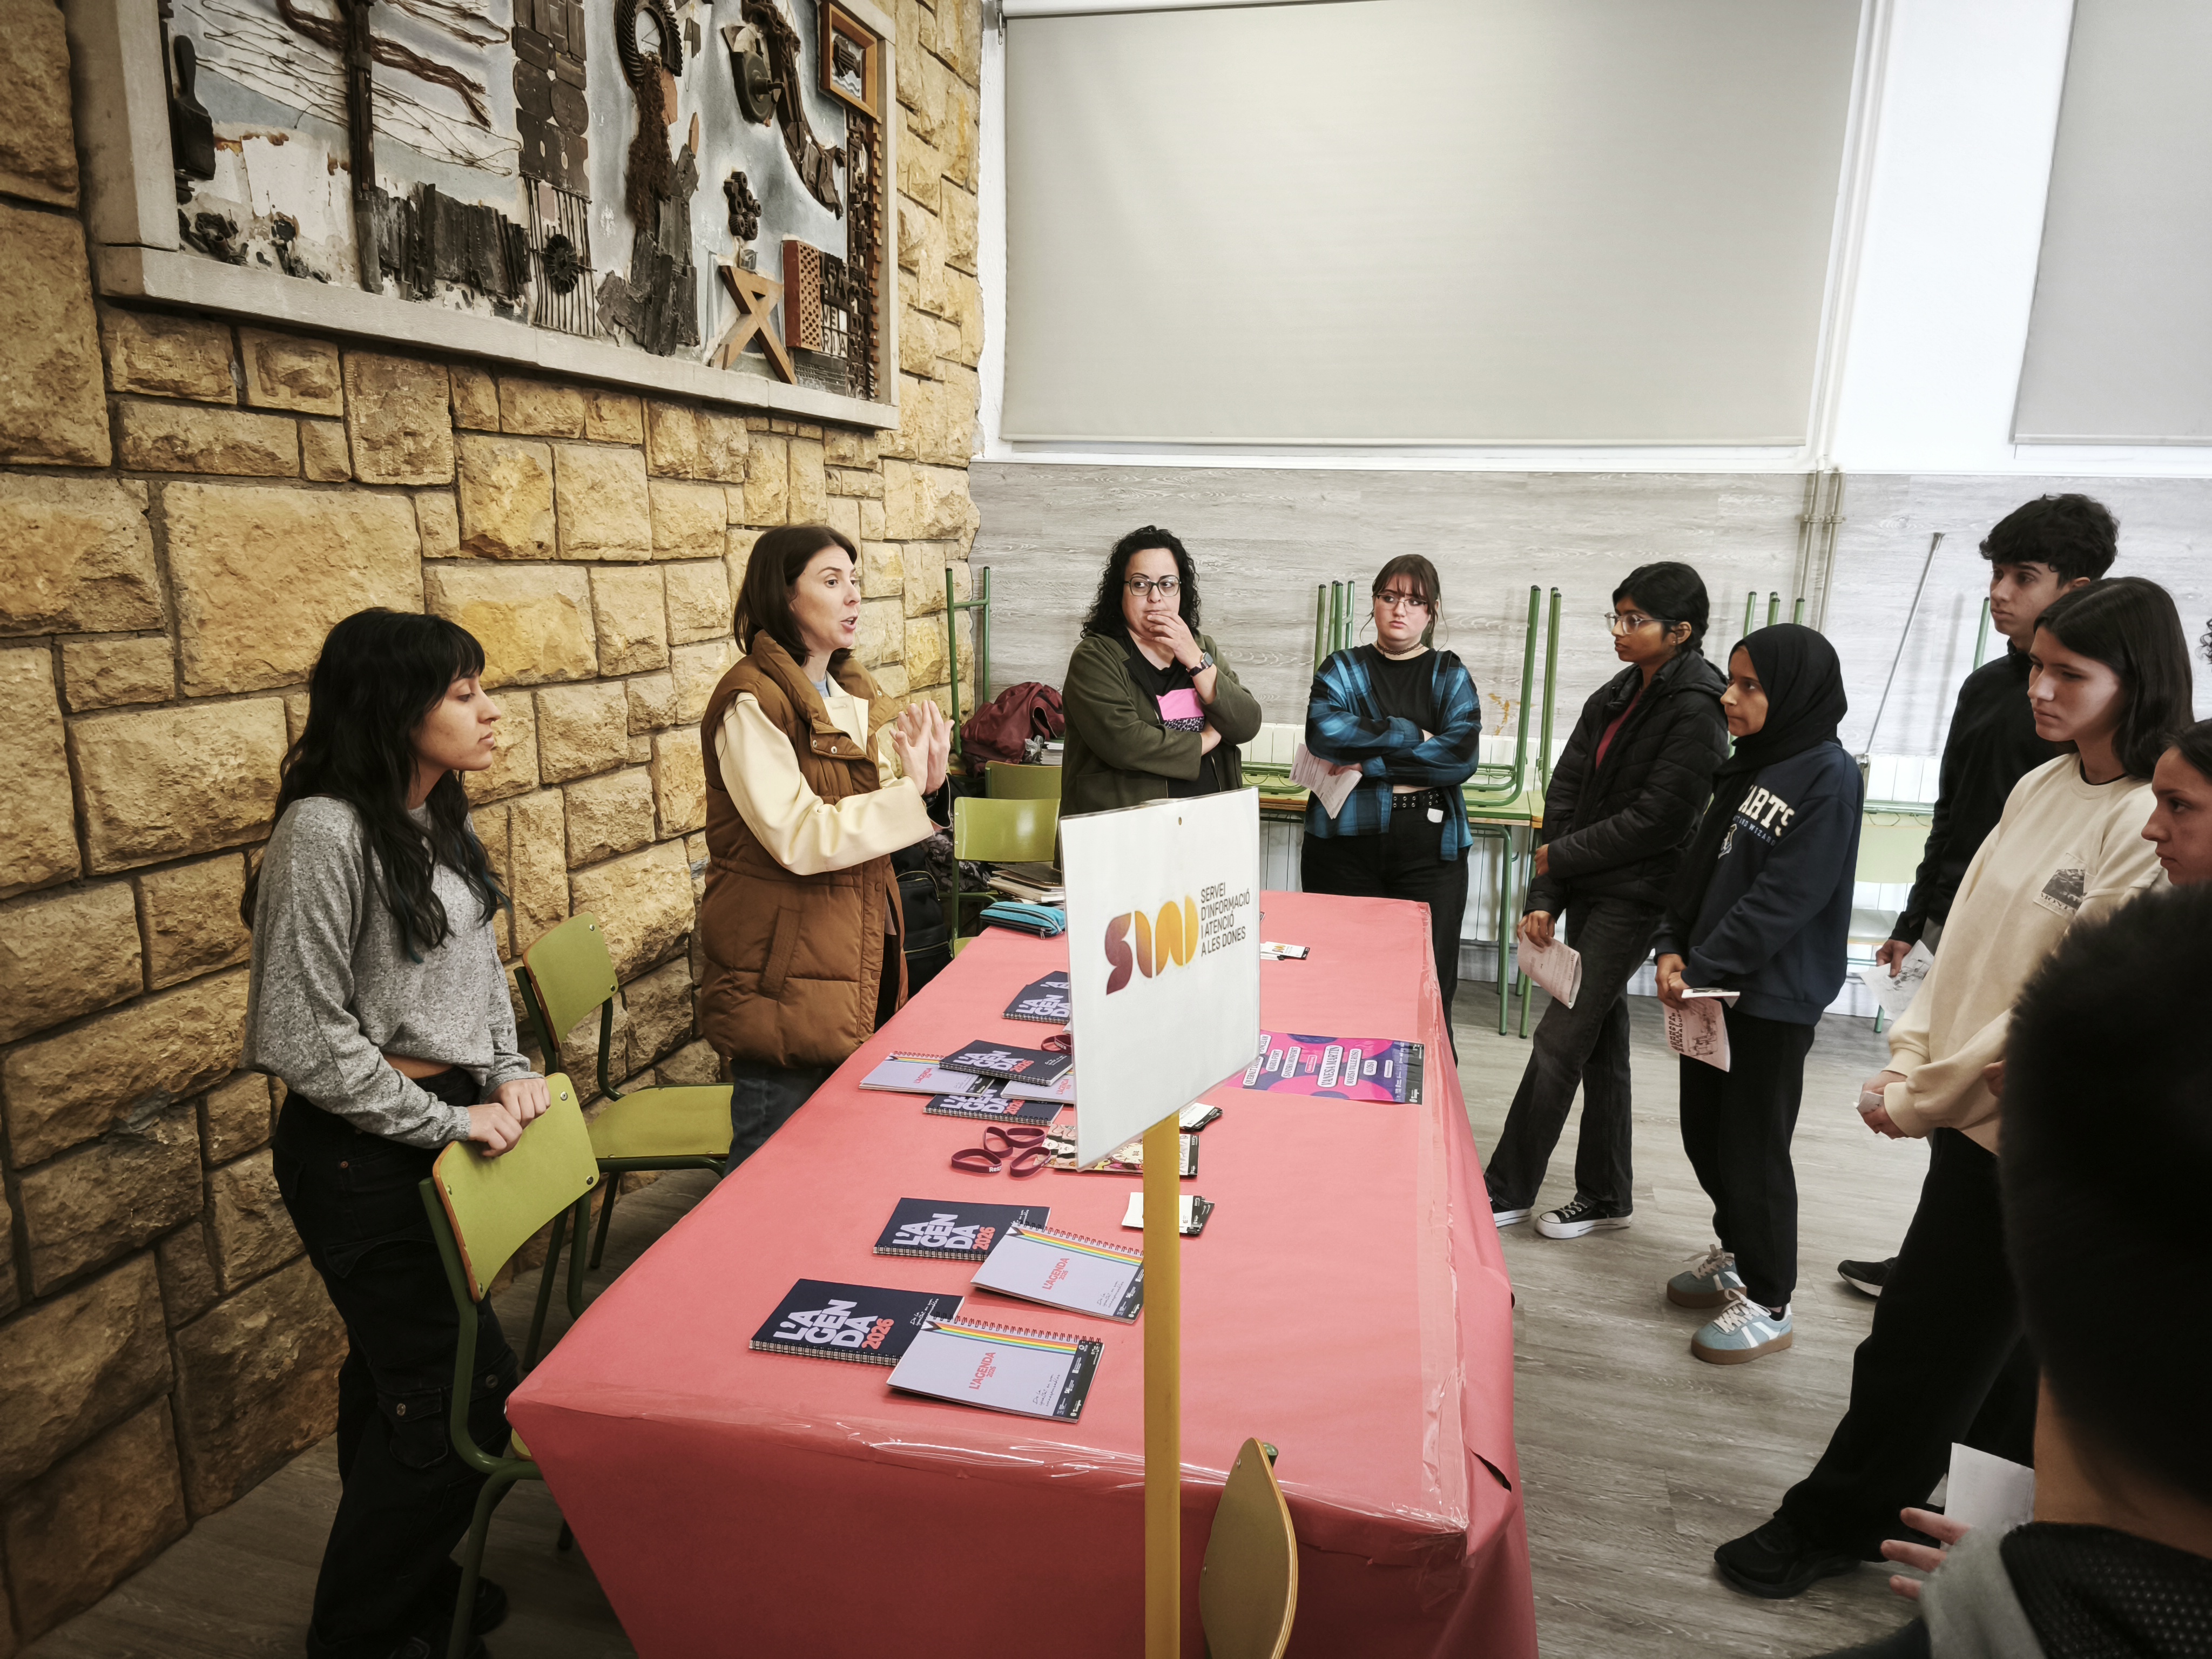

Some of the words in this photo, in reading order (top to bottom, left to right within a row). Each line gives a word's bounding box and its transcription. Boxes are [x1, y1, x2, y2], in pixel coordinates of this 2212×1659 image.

[1201, 882, 1226, 903] SERVEI
[1201, 887, 1250, 921] D'INFORMACIÓ
[1201, 925, 1204, 940] I
[1204, 910, 1235, 937] ATENCIÓ
[1201, 942, 1207, 957] A
[1208, 934, 1220, 954] LES
[1222, 926, 1246, 948] DONES
[1016, 999, 1043, 1014] L'A
[1035, 994, 1064, 1016] GEN
[953, 1053, 985, 1065] L'A
[974, 1050, 1011, 1067] GEN
[990, 1058, 1024, 1071] DA
[1009, 1059, 1034, 1073] 2026
[1326, 1046, 1340, 1065] MARTÍN
[1283, 1063, 1294, 1077] SANDRA
[1321, 1065, 1336, 1085] VANESA
[1346, 1070, 1355, 1084] MARISA
[1366, 1062, 1374, 1073] ALOSA
[892, 1222, 929, 1245] L'A
[920, 1213, 959, 1247] GEN
[944, 1224, 980, 1250] DA
[972, 1226, 996, 1250] 2026
[1042, 1257, 1070, 1290] L'AGENDA
[773, 1310, 822, 1340] L'A
[805, 1299, 858, 1344] GEN
[830, 1316, 879, 1348] DA
[861, 1318, 895, 1350] 2026
[969, 1352, 996, 1390] L'AGENDA
